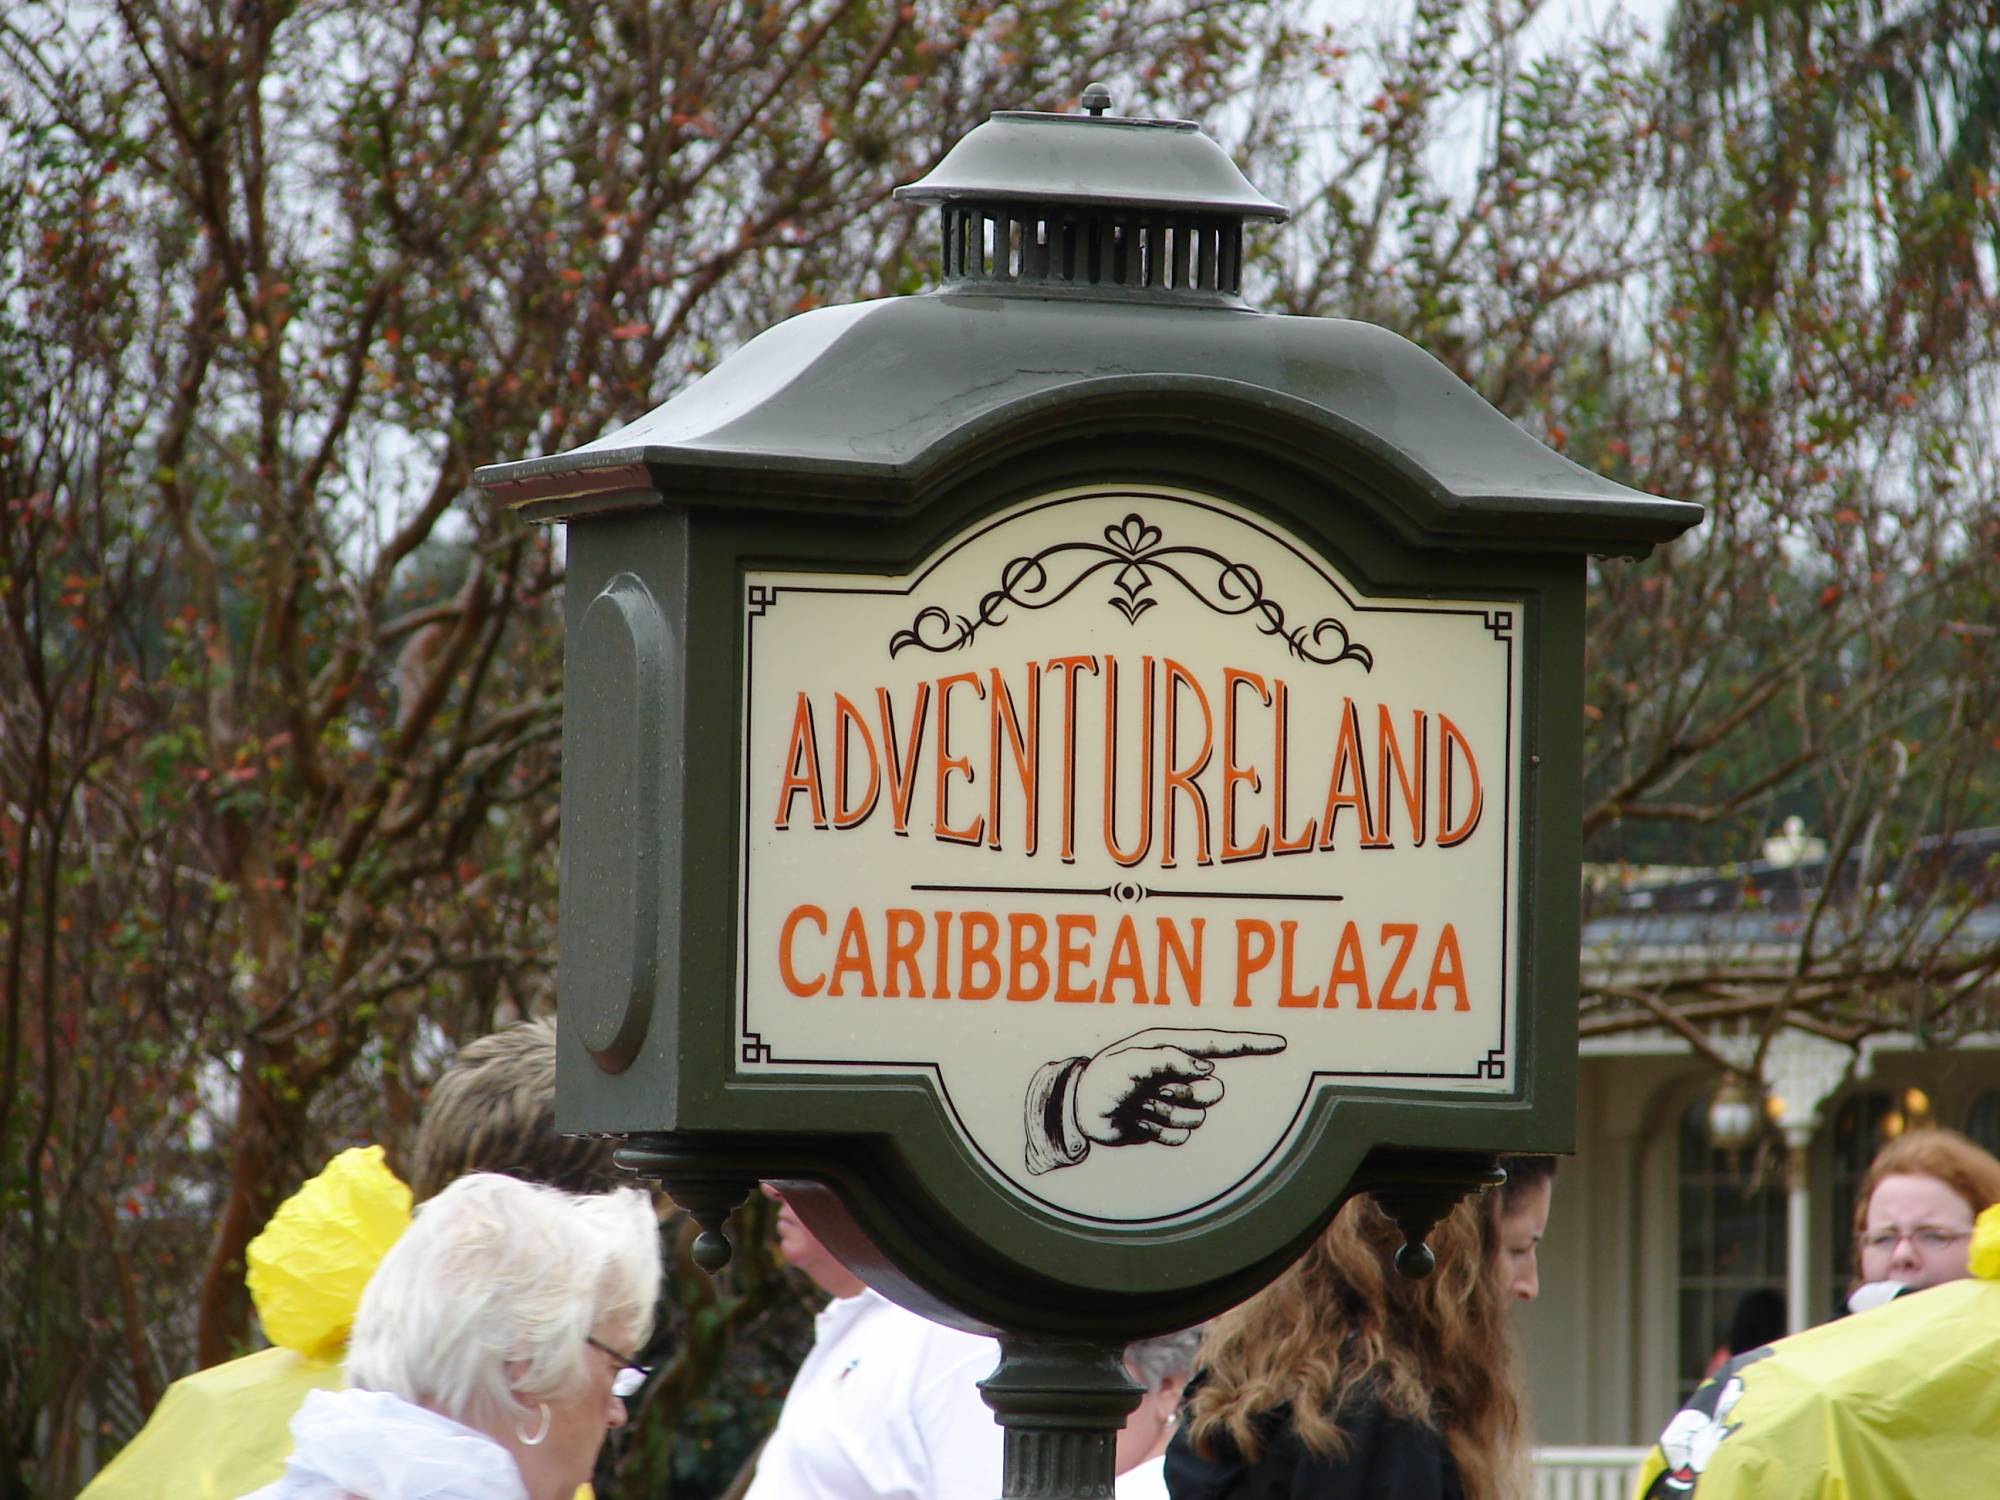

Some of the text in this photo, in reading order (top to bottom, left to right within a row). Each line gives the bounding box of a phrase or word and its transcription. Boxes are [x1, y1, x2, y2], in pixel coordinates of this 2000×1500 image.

[774, 654, 1484, 869] ADVENTURELAND
[778, 903, 1472, 1013] CARIBBEAN PLAZA
